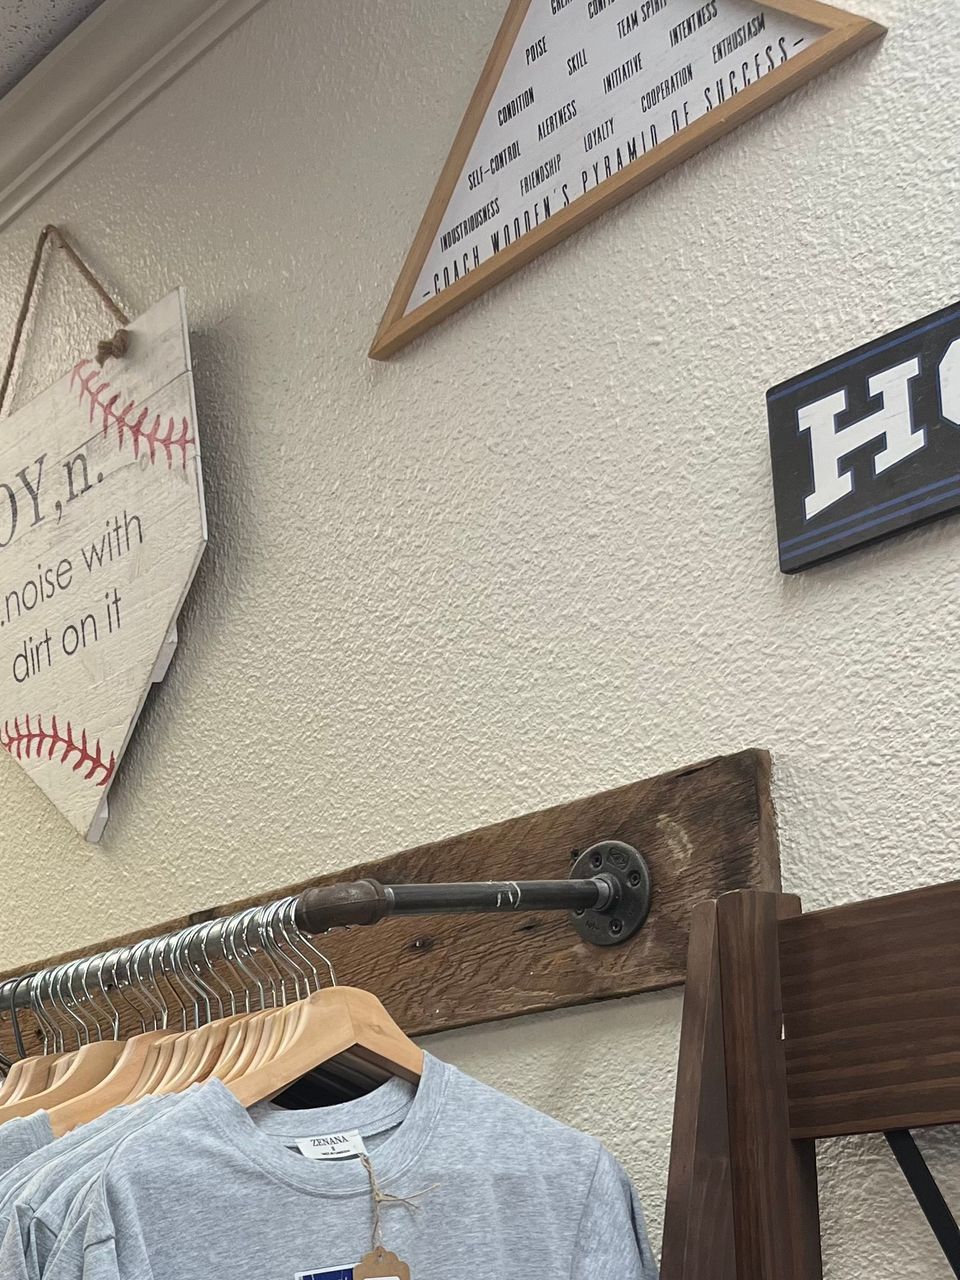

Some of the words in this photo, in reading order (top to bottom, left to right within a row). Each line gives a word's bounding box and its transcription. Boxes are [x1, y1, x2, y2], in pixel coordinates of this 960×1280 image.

[616, 10, 639, 40] TEAM
[669, 0, 718, 48] INTENTNESS
[712, 12, 766, 64] ENTHUSIASM
[525, 35, 548, 66] POISE
[566, 48, 588, 76] SKILL
[603, 52, 643, 95] INITIATIVE
[640, 62, 694, 113] COOPERATION
[497, 86, 535, 127] CONDITION
[537, 100, 578, 142] ALERTNESS
[581, 124, 658, 193] PYRAMID
[671, 101, 690, 135] OF
[583, 117, 615, 153] LOYALTY
[468, 140, 522, 191] SELF-CONTROL
[520, 153, 562, 197] FRIENDSHIP
[440, 197, 501, 253] INDUSTRIOUSNESS
[81, 510, 144, 573] with
[12, 628, 53, 684] dirt
[62, 613, 98, 657] on
[105, 588, 122, 634] it
[310, 1135, 349, 1147] ZENANA
